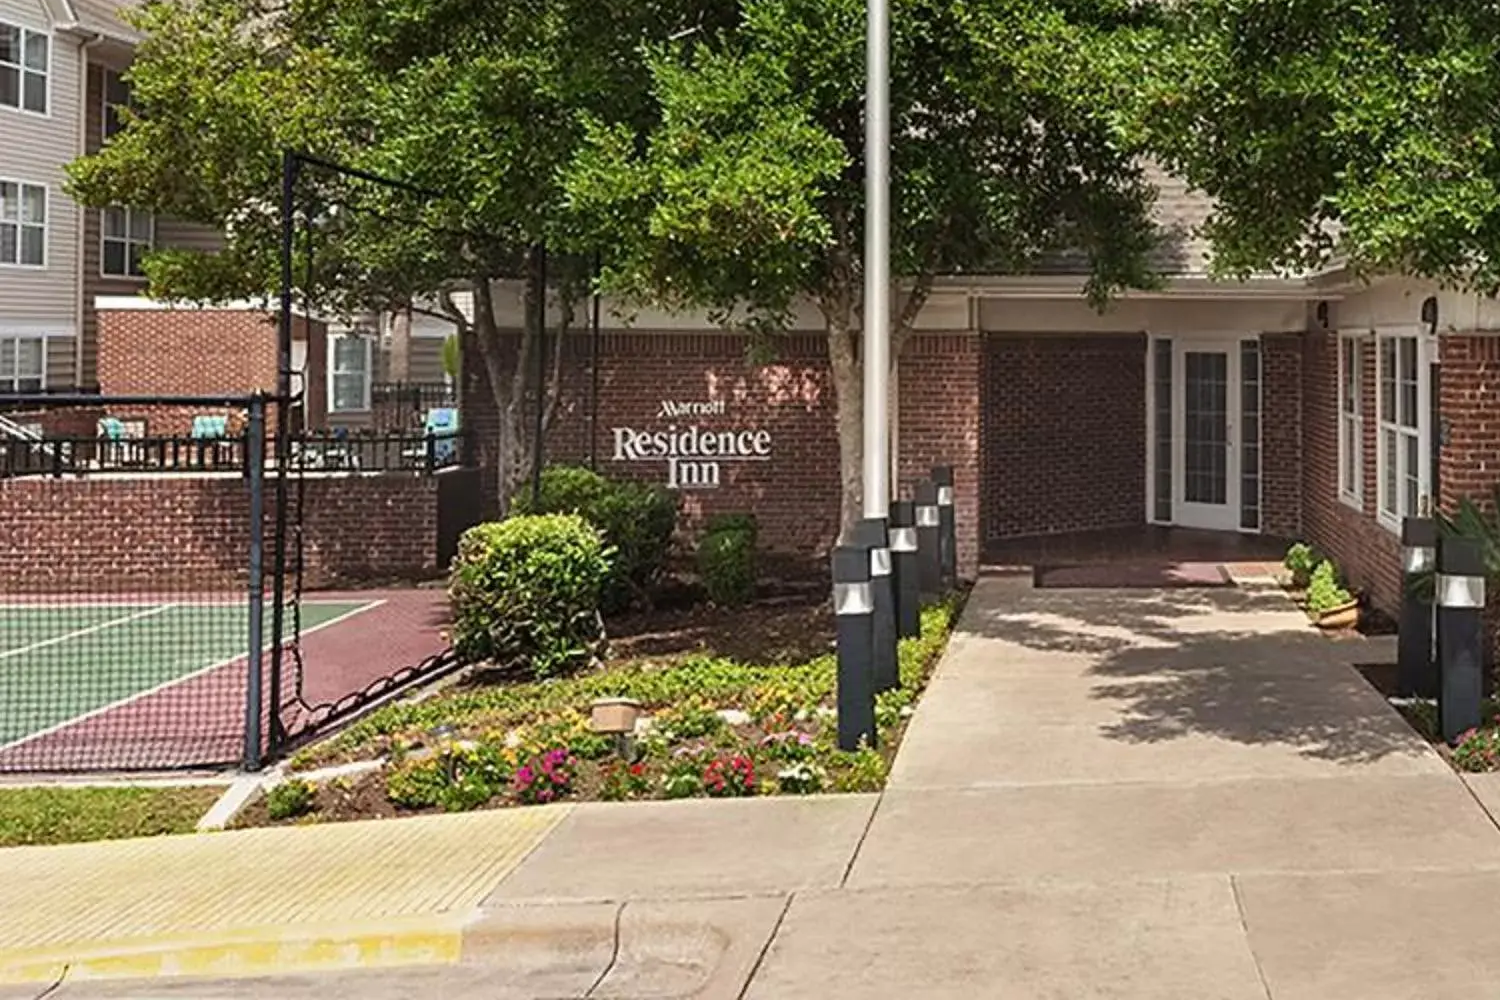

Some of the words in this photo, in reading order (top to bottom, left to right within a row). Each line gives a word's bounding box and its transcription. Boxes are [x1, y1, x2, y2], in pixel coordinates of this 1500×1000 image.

[656, 400, 726, 417] Marriott
[611, 425, 771, 460] Residence
[666, 457, 720, 489] Inn
